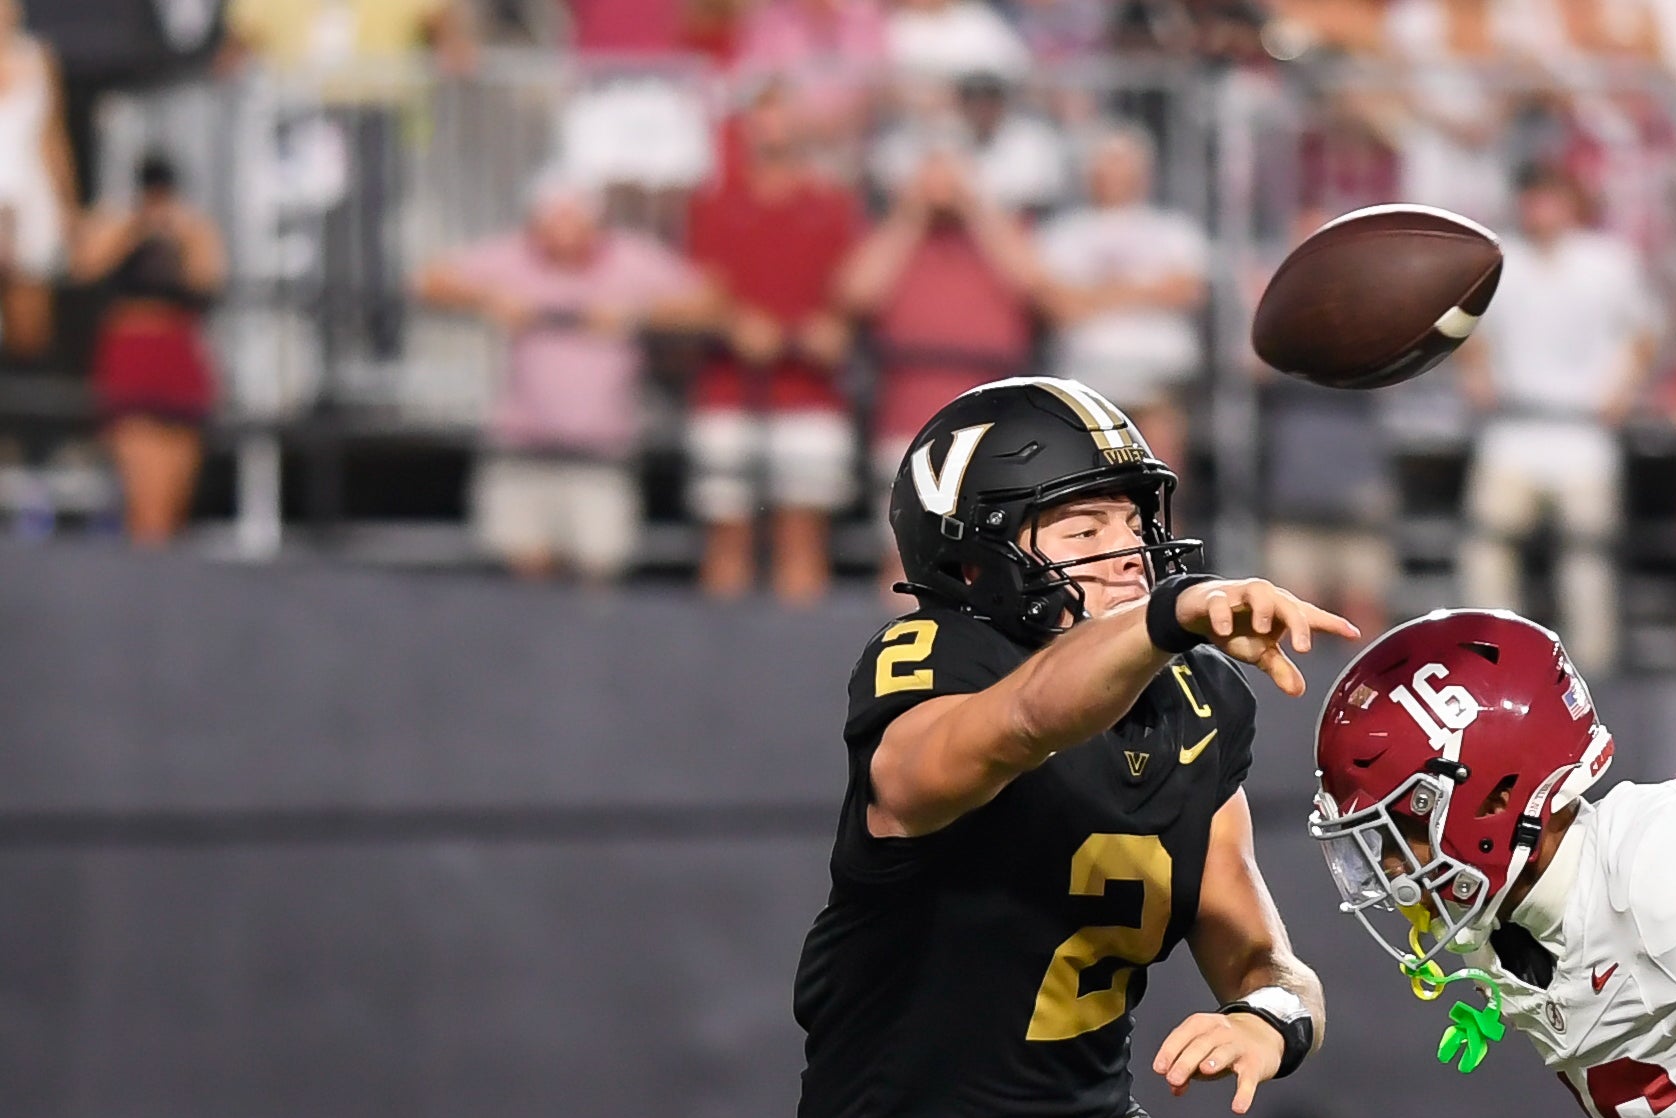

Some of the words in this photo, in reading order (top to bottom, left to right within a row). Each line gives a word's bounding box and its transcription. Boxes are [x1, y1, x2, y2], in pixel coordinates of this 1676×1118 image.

[910, 422, 994, 517] V
[875, 619, 939, 698] 2
[1389, 662, 1479, 750] 16
[1123, 751, 1151, 777] V
[1026, 833, 1172, 1041] 2
